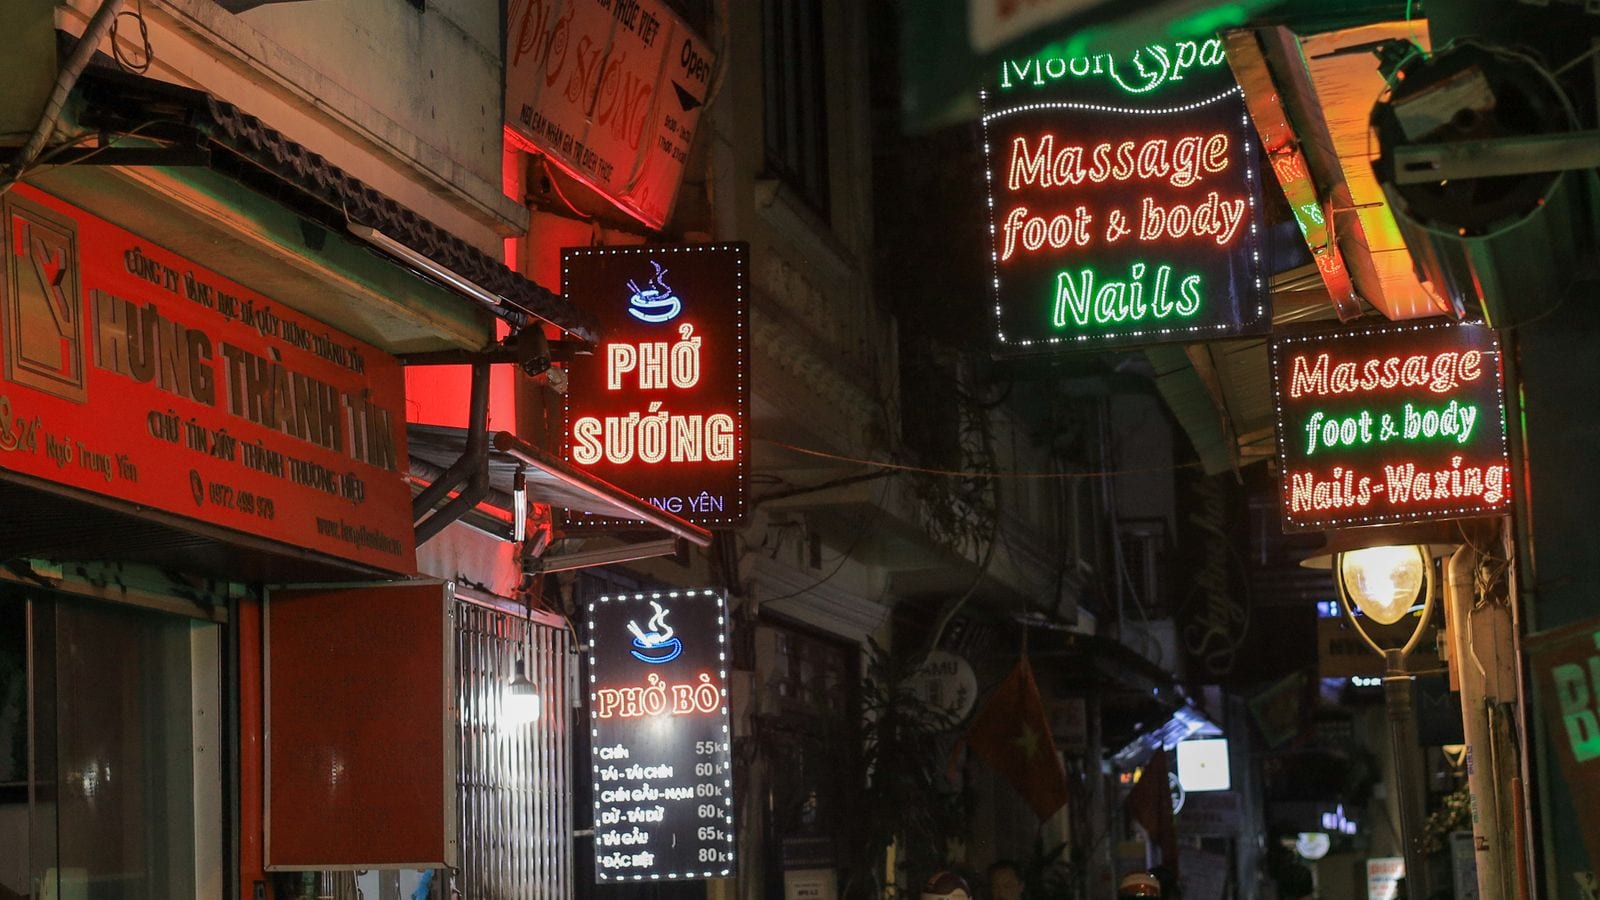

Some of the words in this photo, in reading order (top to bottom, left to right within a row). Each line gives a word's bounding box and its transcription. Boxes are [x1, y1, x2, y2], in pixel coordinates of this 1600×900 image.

[680, 38, 710, 84] Open
[1008, 133, 1229, 190] Massage
[1001, 206, 1092, 262] foot
[1106, 209, 1131, 242] &
[1139, 192, 1245, 245] body
[124, 246, 161, 285] CÔNG
[160, 264, 180, 295] TY
[1053, 263, 1201, 327] Nails
[90, 288, 216, 408] HƯNG
[219, 341, 342, 454] THÀNH
[341, 387, 397, 473] TÍN
[607, 323, 702, 390] PHỞ
[1291, 350, 1481, 397] Massage
[183, 417, 209, 455] TÍN
[239, 437, 285, 479] THÀNH
[573, 401, 735, 465] SƯỚNG
[1305, 411, 1373, 455] foot
[1380, 414, 1399, 442] &
[1403, 399, 1477, 444] body
[76, 440, 113, 482] Trung
[115, 452, 140, 483] Yên
[687, 490, 724, 513] YÊN
[598, 673, 667, 719] PHỞ
[672, 673, 720, 715] BÒ
